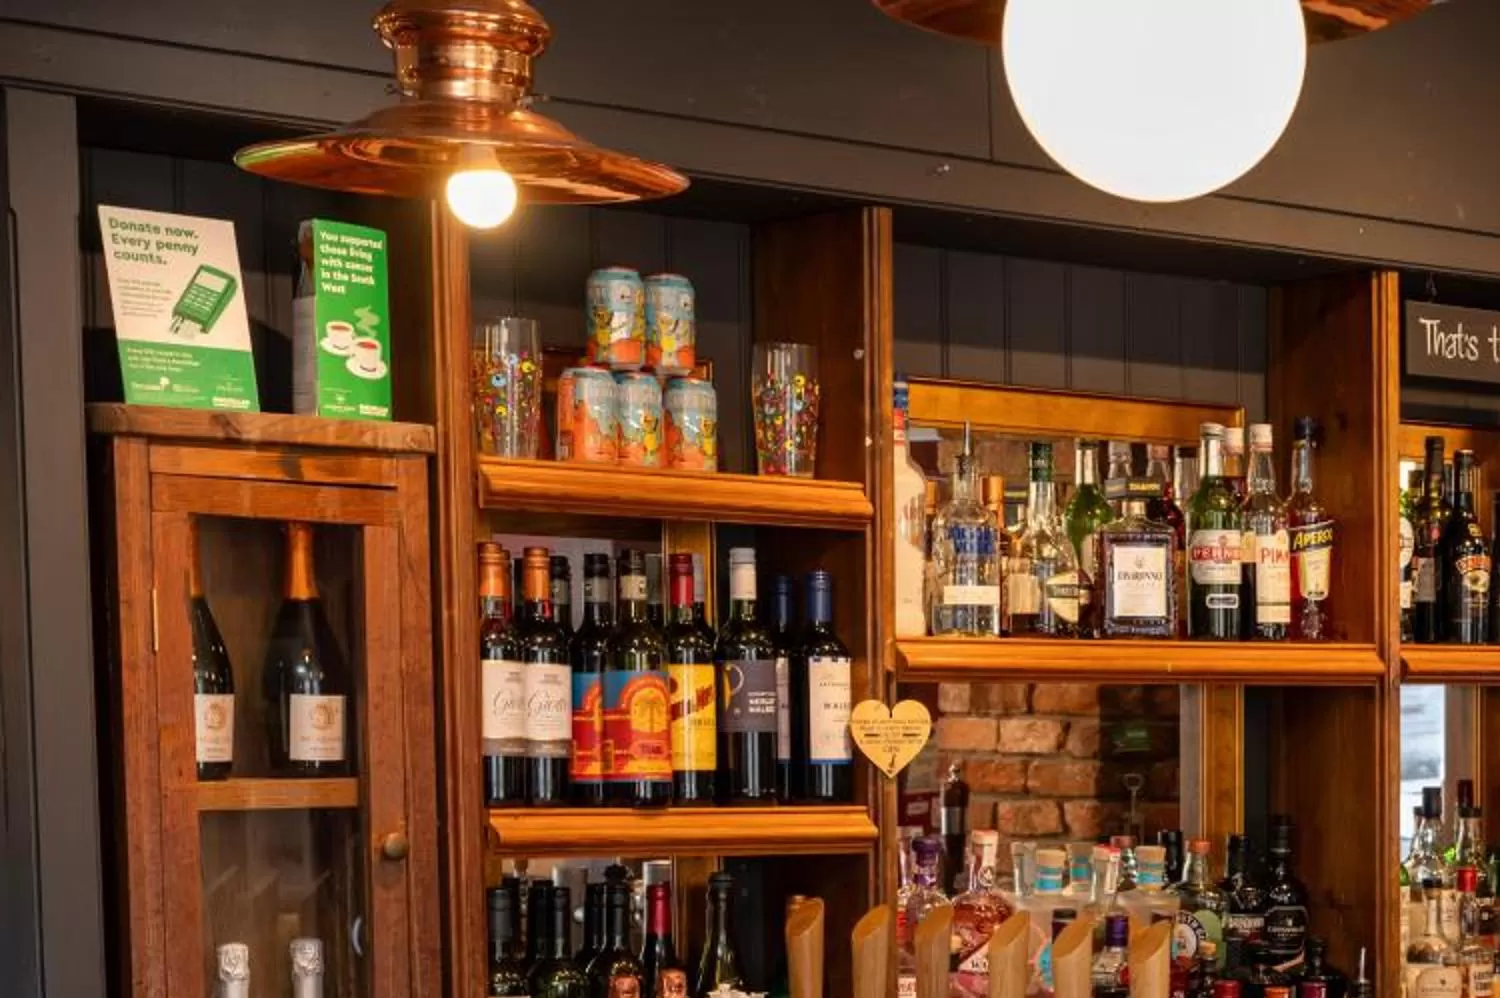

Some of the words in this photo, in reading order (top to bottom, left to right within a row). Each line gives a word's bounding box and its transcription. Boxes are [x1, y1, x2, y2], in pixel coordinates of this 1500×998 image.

[108, 217, 161, 235] Donate
[165, 226, 199, 239] now.
[111, 233, 151, 250] Every
[156, 239, 199, 256] penny
[113, 250, 167, 265] counts.
[320, 268, 331, 279] in
[321, 282, 345, 294] West
